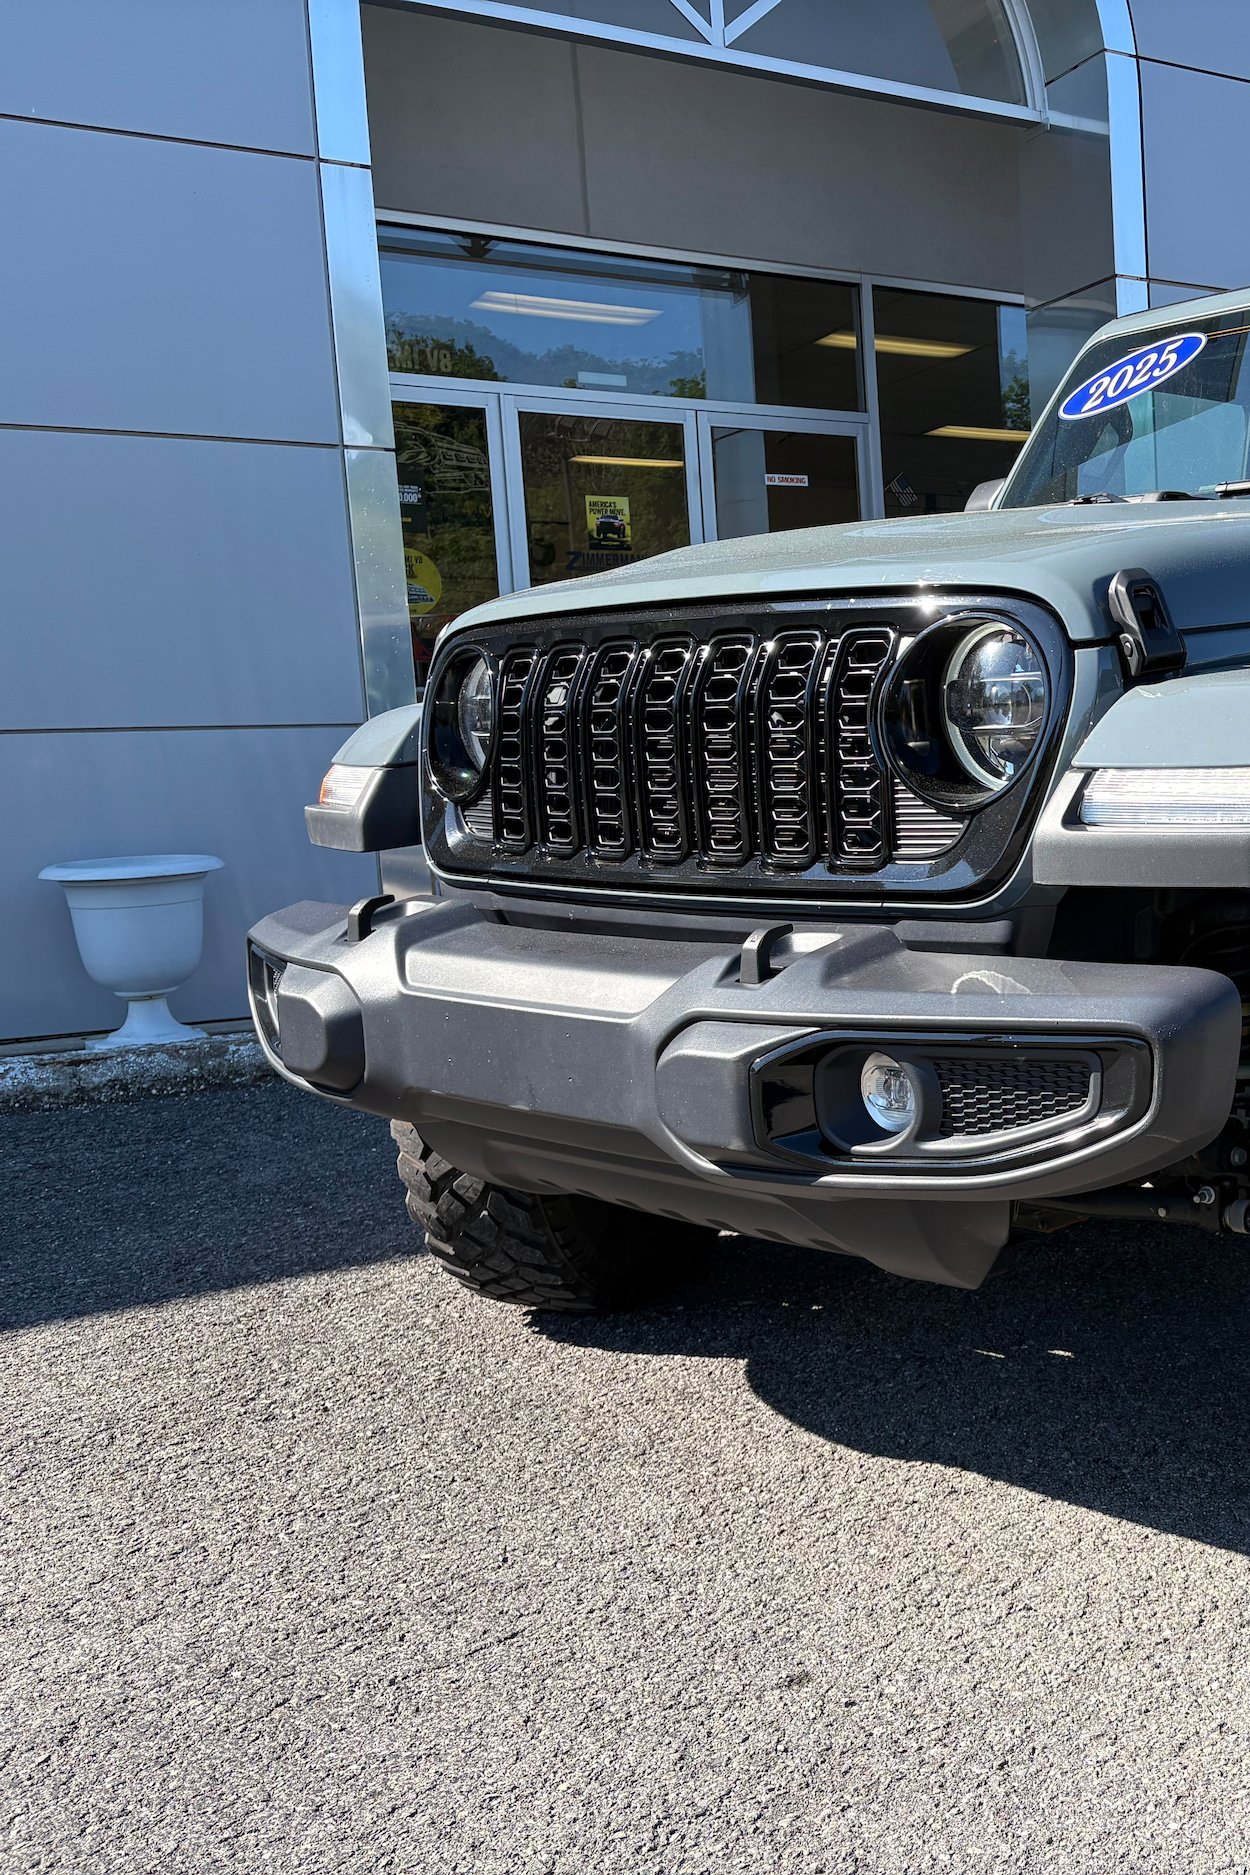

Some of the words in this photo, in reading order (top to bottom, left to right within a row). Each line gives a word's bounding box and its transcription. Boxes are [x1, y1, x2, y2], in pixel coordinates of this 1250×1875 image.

[426, 349, 452, 372] V8
[1081, 339, 1184, 413] 2025
[777, 476, 806, 484] SMOKING
[589, 508, 608, 516] POWER
